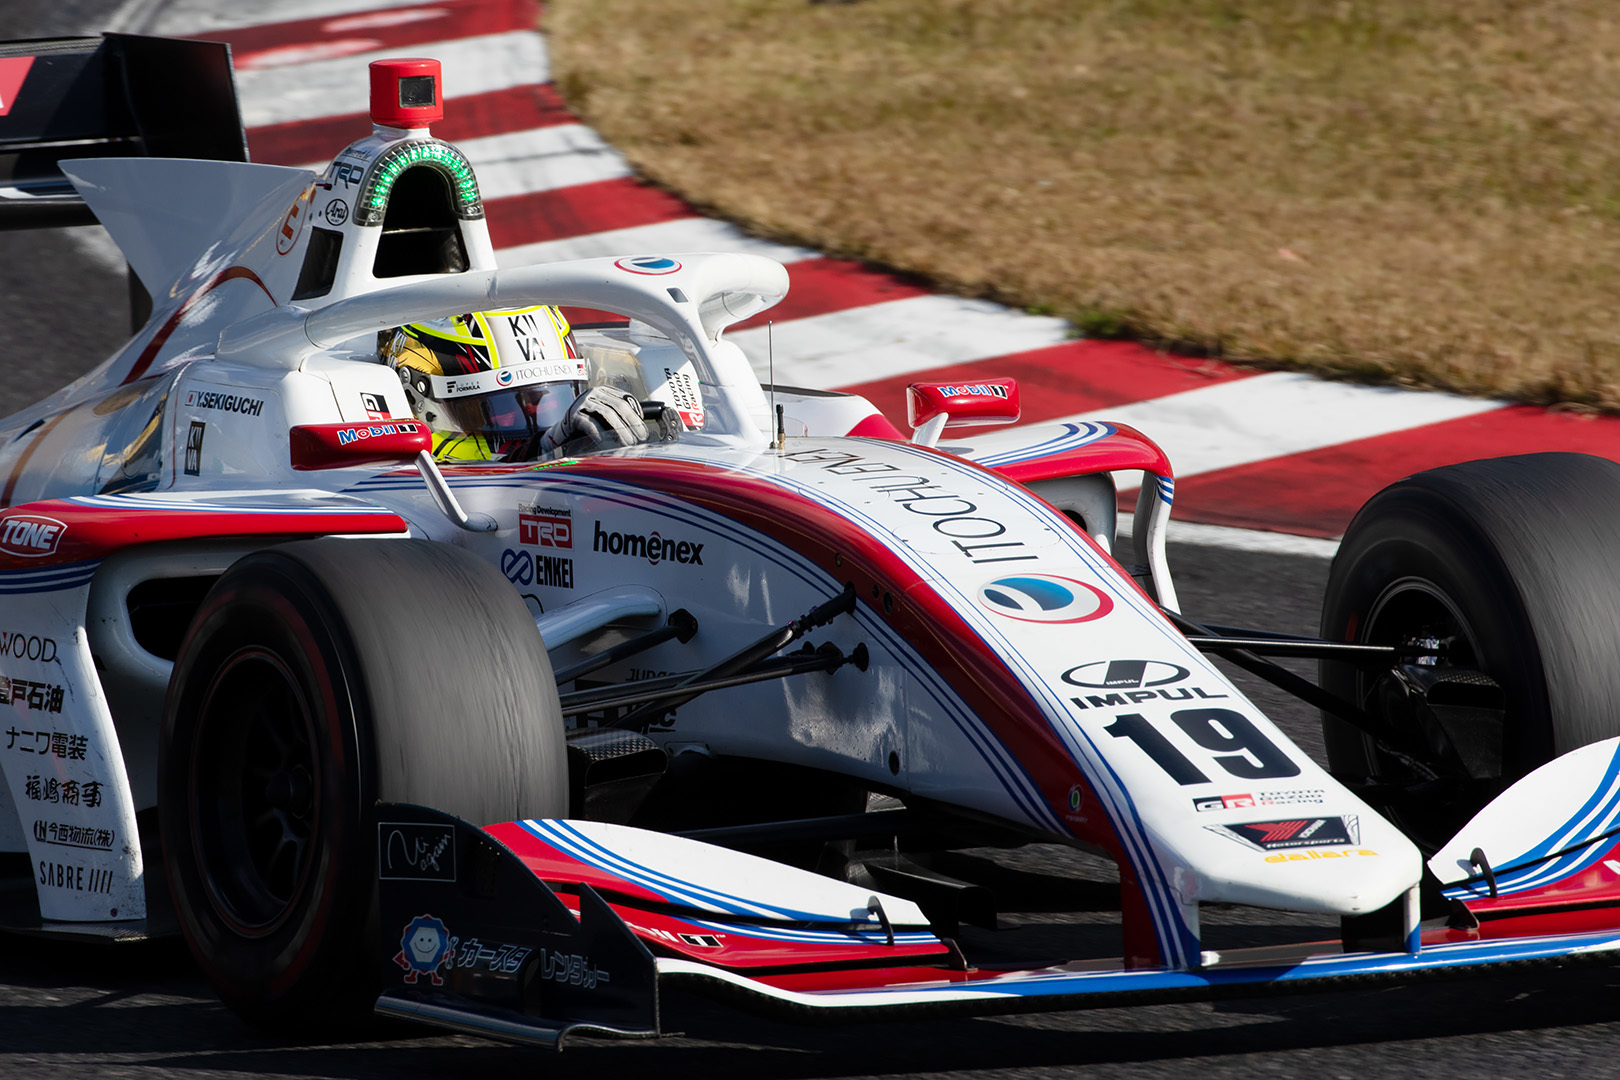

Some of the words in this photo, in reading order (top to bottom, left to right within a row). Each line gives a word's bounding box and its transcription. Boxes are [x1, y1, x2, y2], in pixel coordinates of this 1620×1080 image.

[664, 367, 682, 408] TOYOTA
[673, 371, 691, 410] GAZOO
[937, 384, 992, 398] Mobil
[196, 391, 264, 417] Y.SEKIGUCHI
[337, 425, 396, 445] Mobil
[518, 503, 537, 515] Racing
[537, 505, 571, 517] Development
[852, 475, 1039, 565] ITOCHU
[1, 519, 60, 550] TONE
[521, 519, 570, 549] TRD
[536, 555, 574, 589] ENKEI
[1069, 687, 1229, 710] IMPUL
[6, 726, 89, 761] ナニワ電装
[1103, 708, 1302, 786] 19
[1264, 849, 1381, 864] dallara
[40, 860, 85, 891] SABRE
